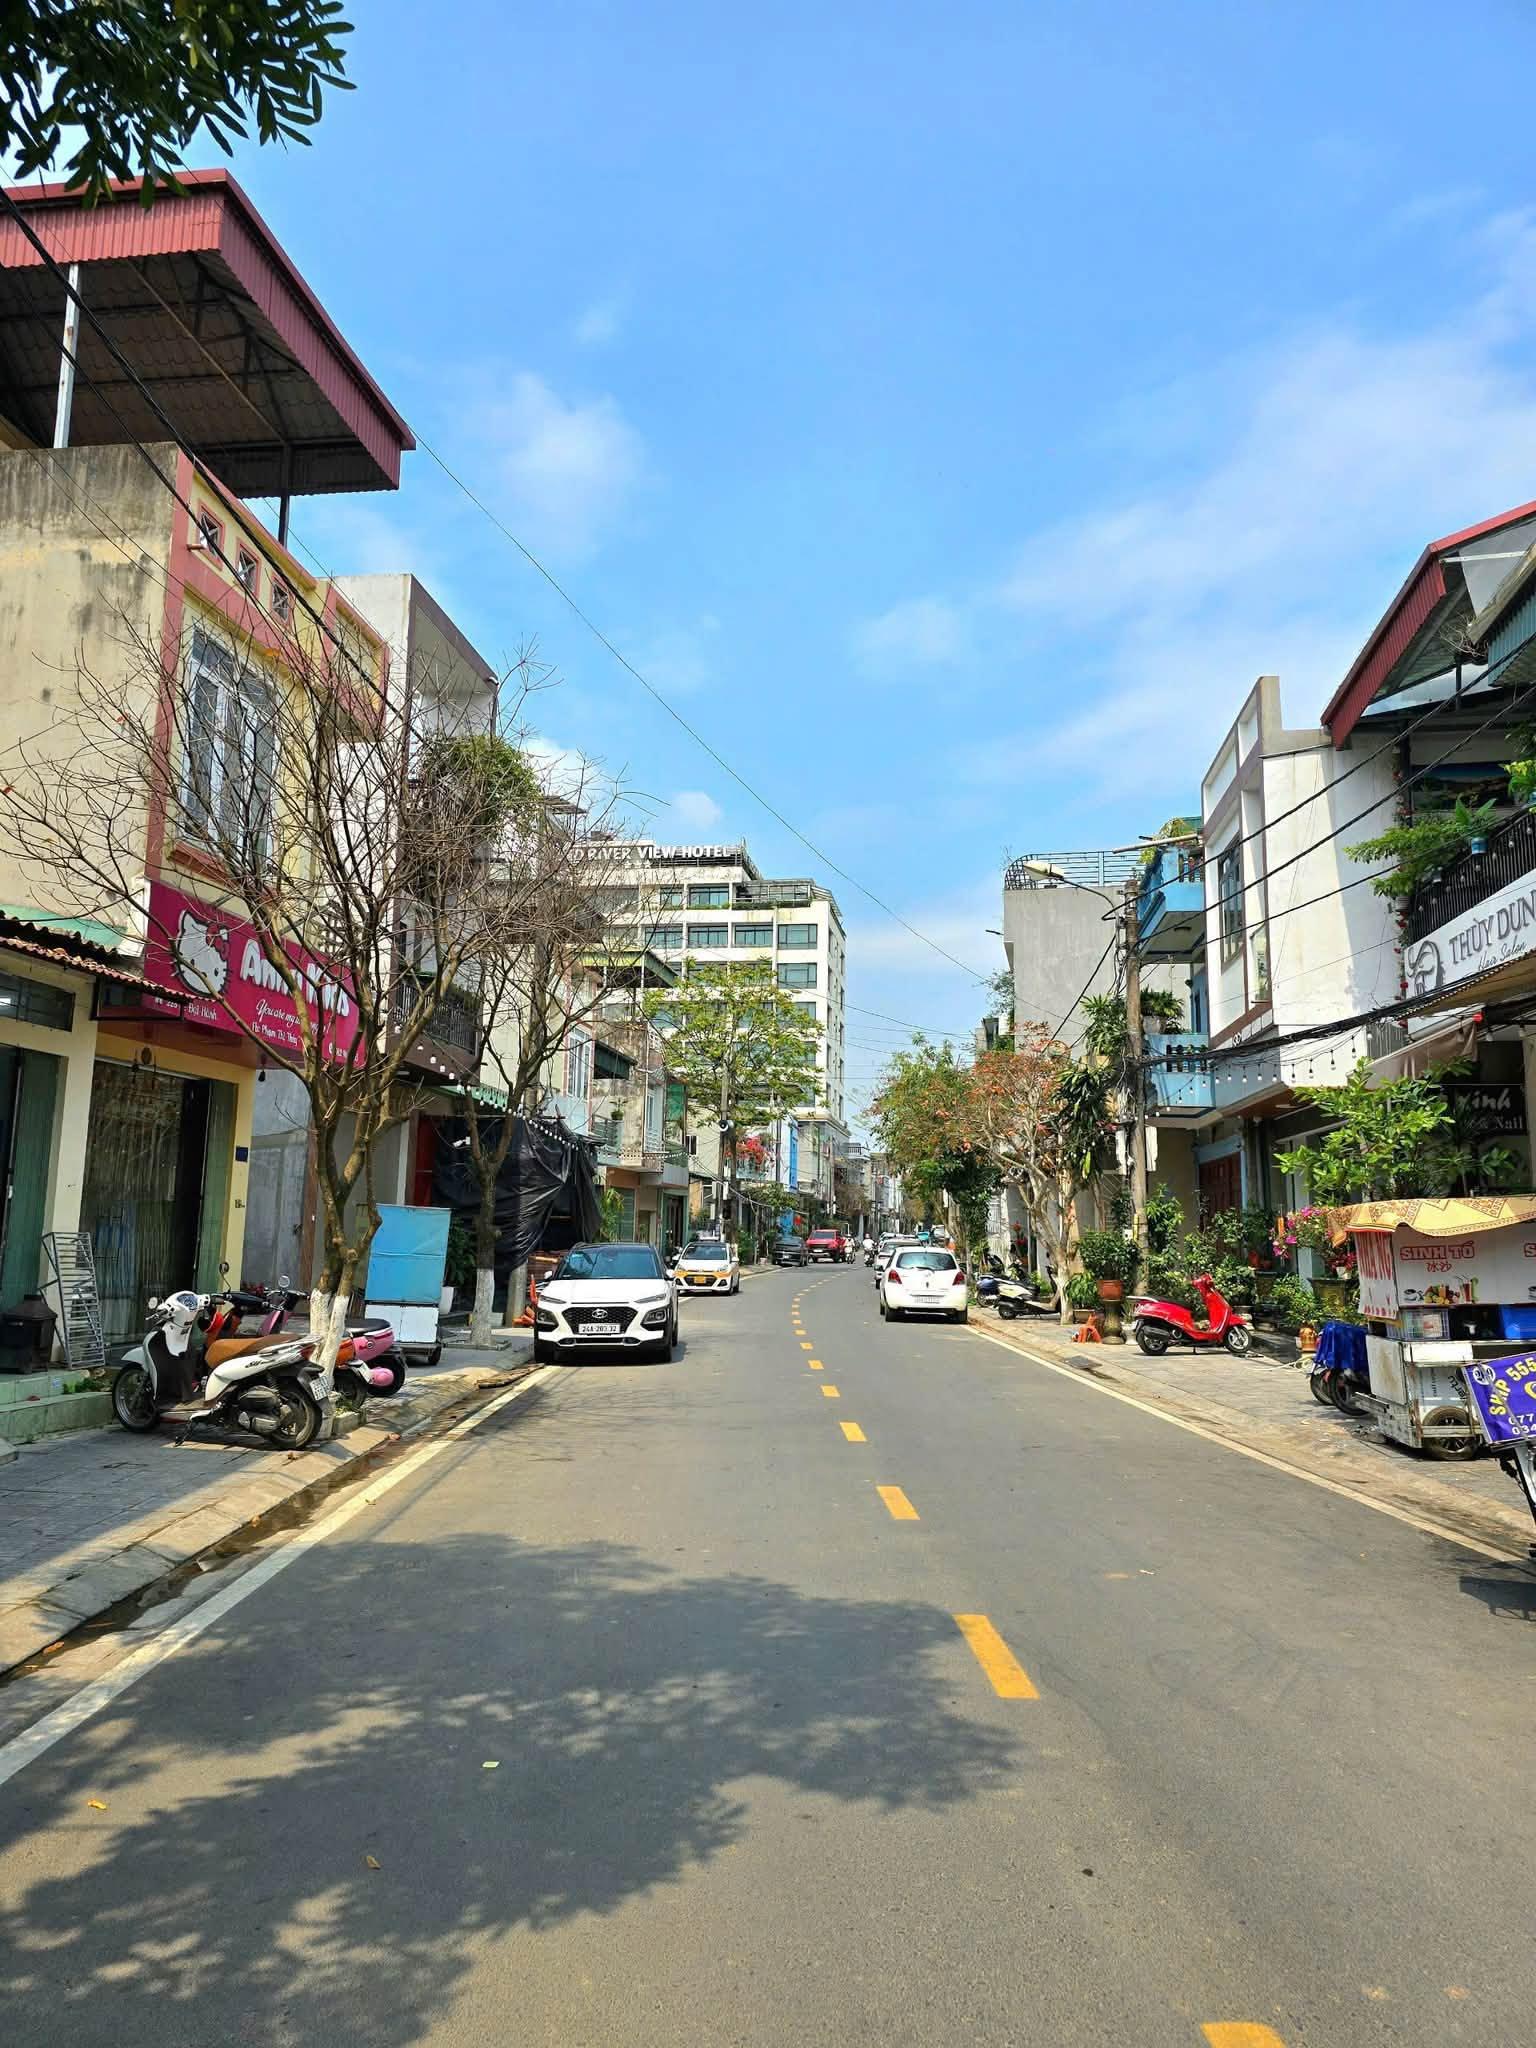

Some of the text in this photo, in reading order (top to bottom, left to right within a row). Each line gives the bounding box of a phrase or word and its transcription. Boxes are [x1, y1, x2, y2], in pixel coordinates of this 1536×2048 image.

[588, 847, 631, 860] RIVER
[638, 846, 676, 859] VIEW
[682, 845, 730, 858] HOTEL
[1448, 915, 1495, 964] THÙY
[1500, 935, 1527, 961] Salon
[1400, 1240, 1475, 1260] SINH TỐ
